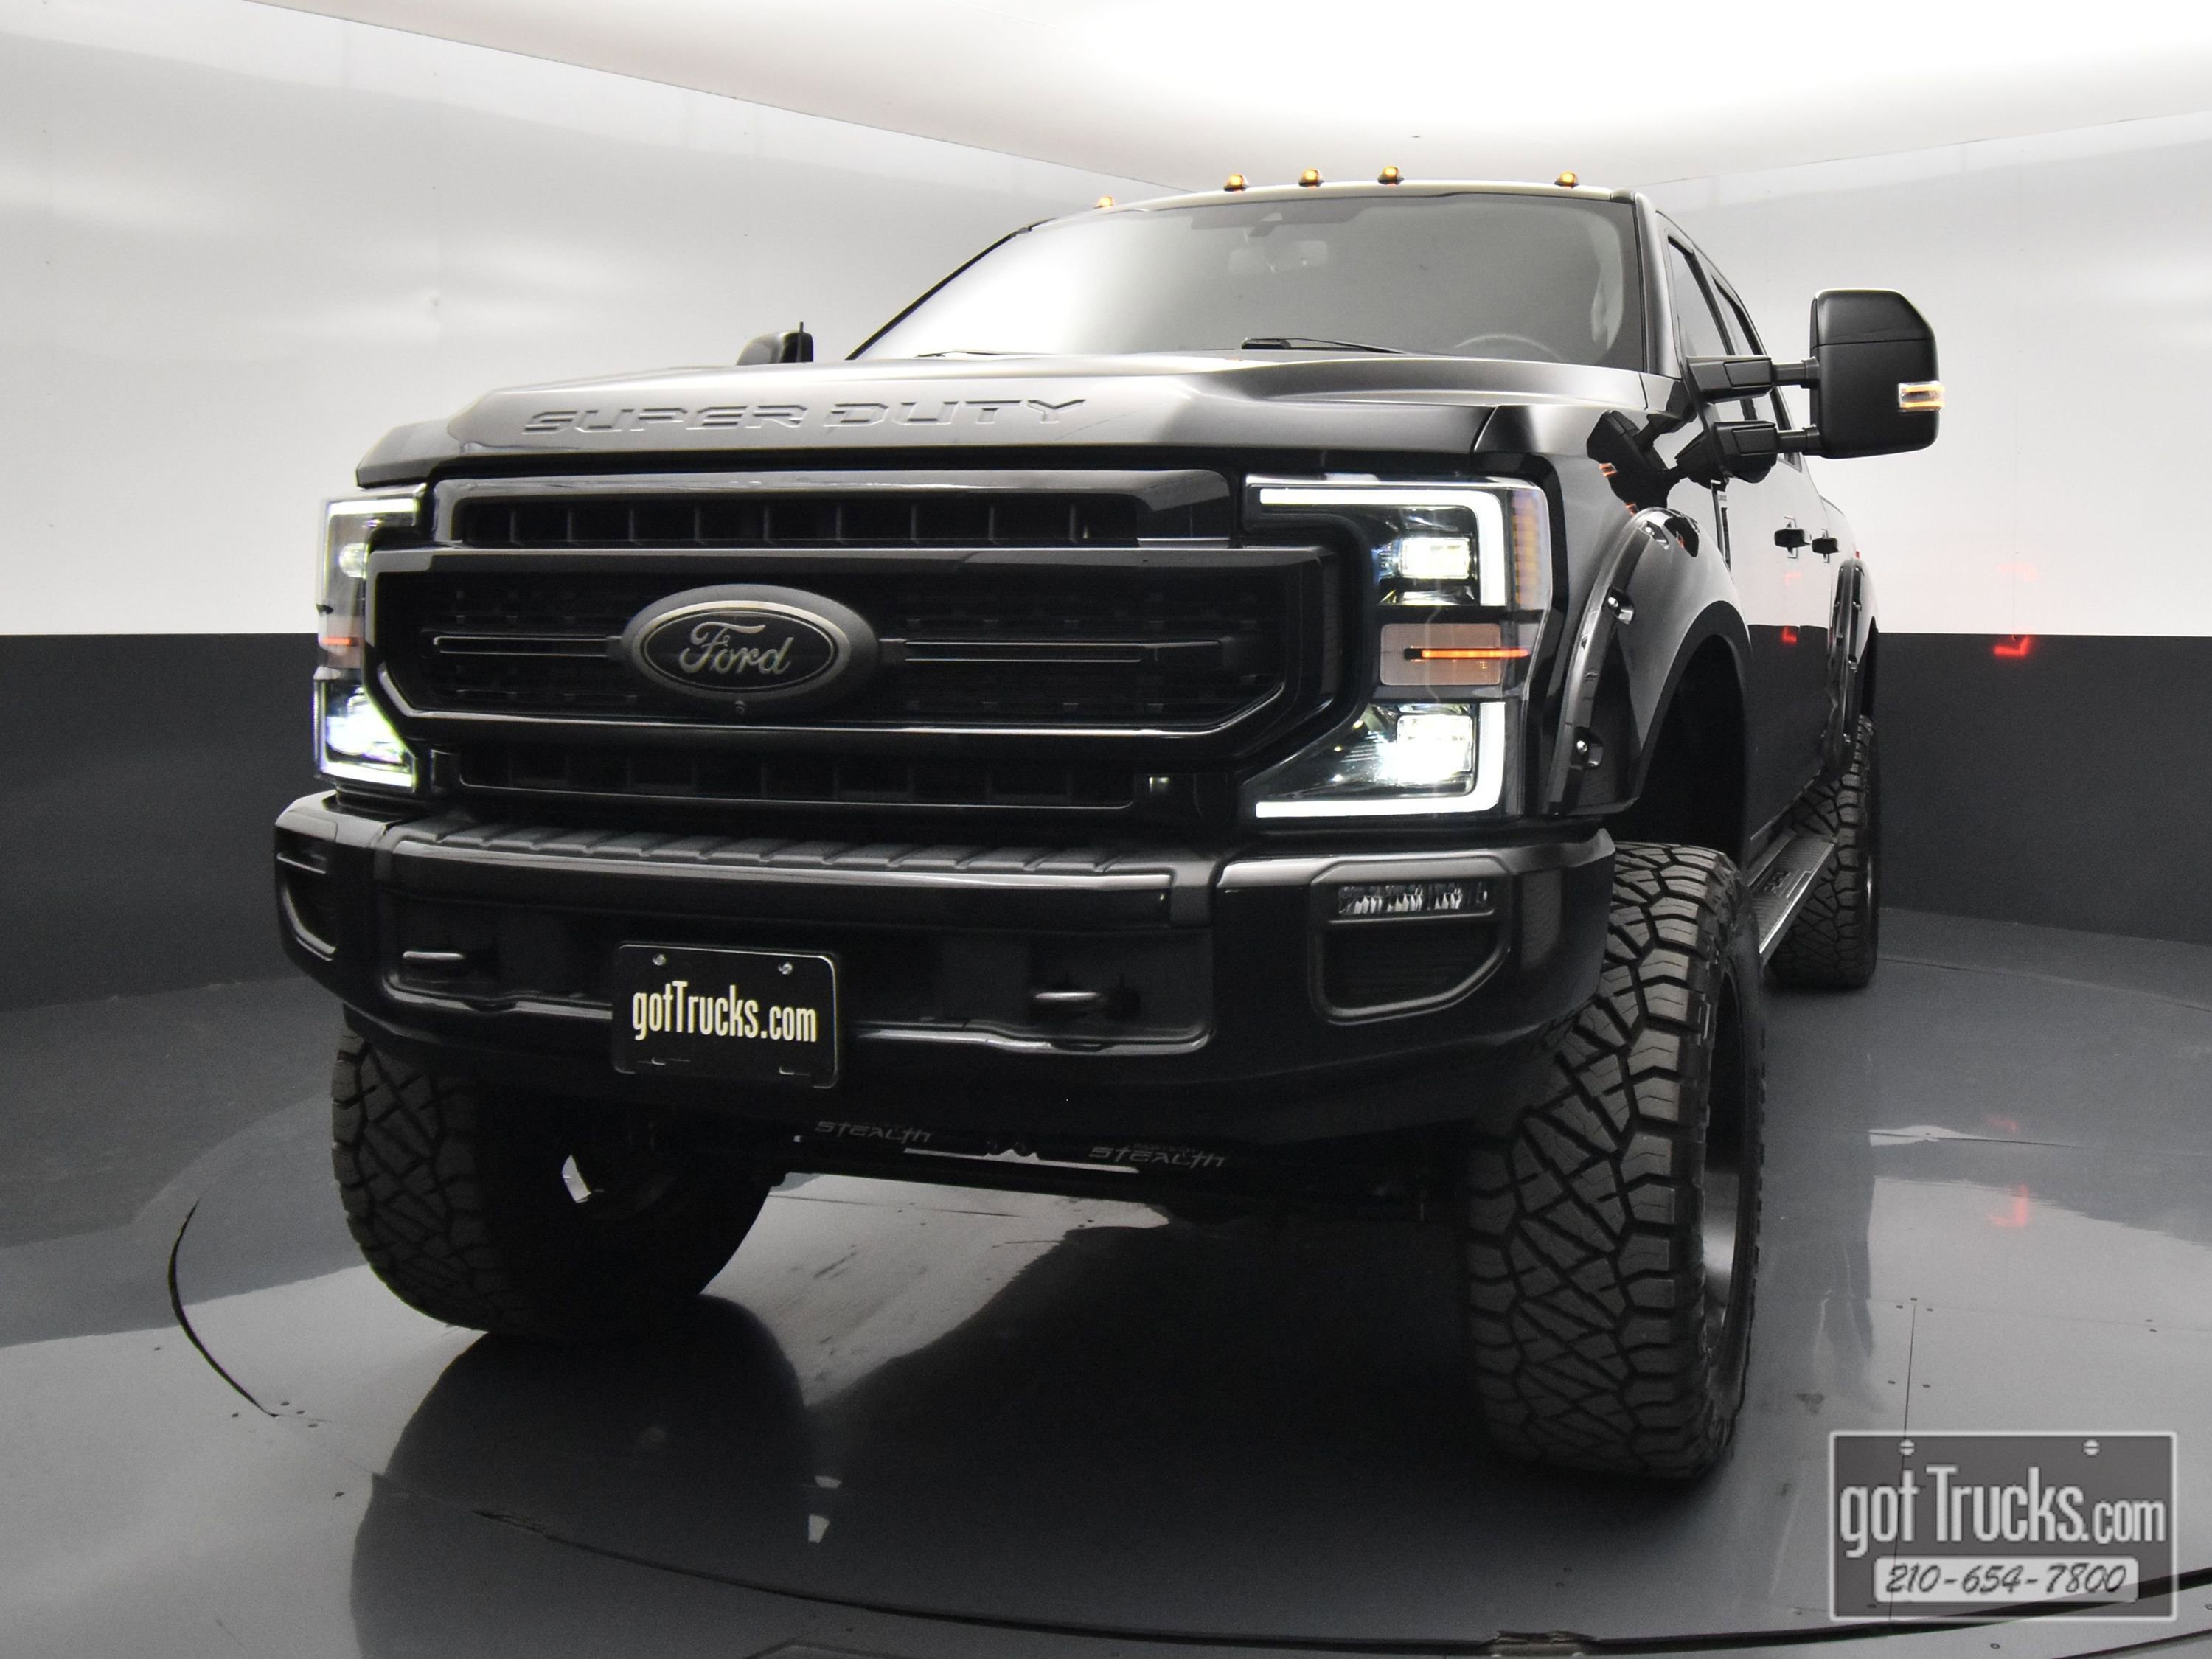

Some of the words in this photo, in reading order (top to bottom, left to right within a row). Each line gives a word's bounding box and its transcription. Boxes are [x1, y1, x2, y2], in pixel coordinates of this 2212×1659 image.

[521, 403, 808, 433] SUPER
[822, 398, 1087, 428] DUTY
[678, 621, 794, 675] Ford
[632, 980, 817, 1043] gotTrucks.com
